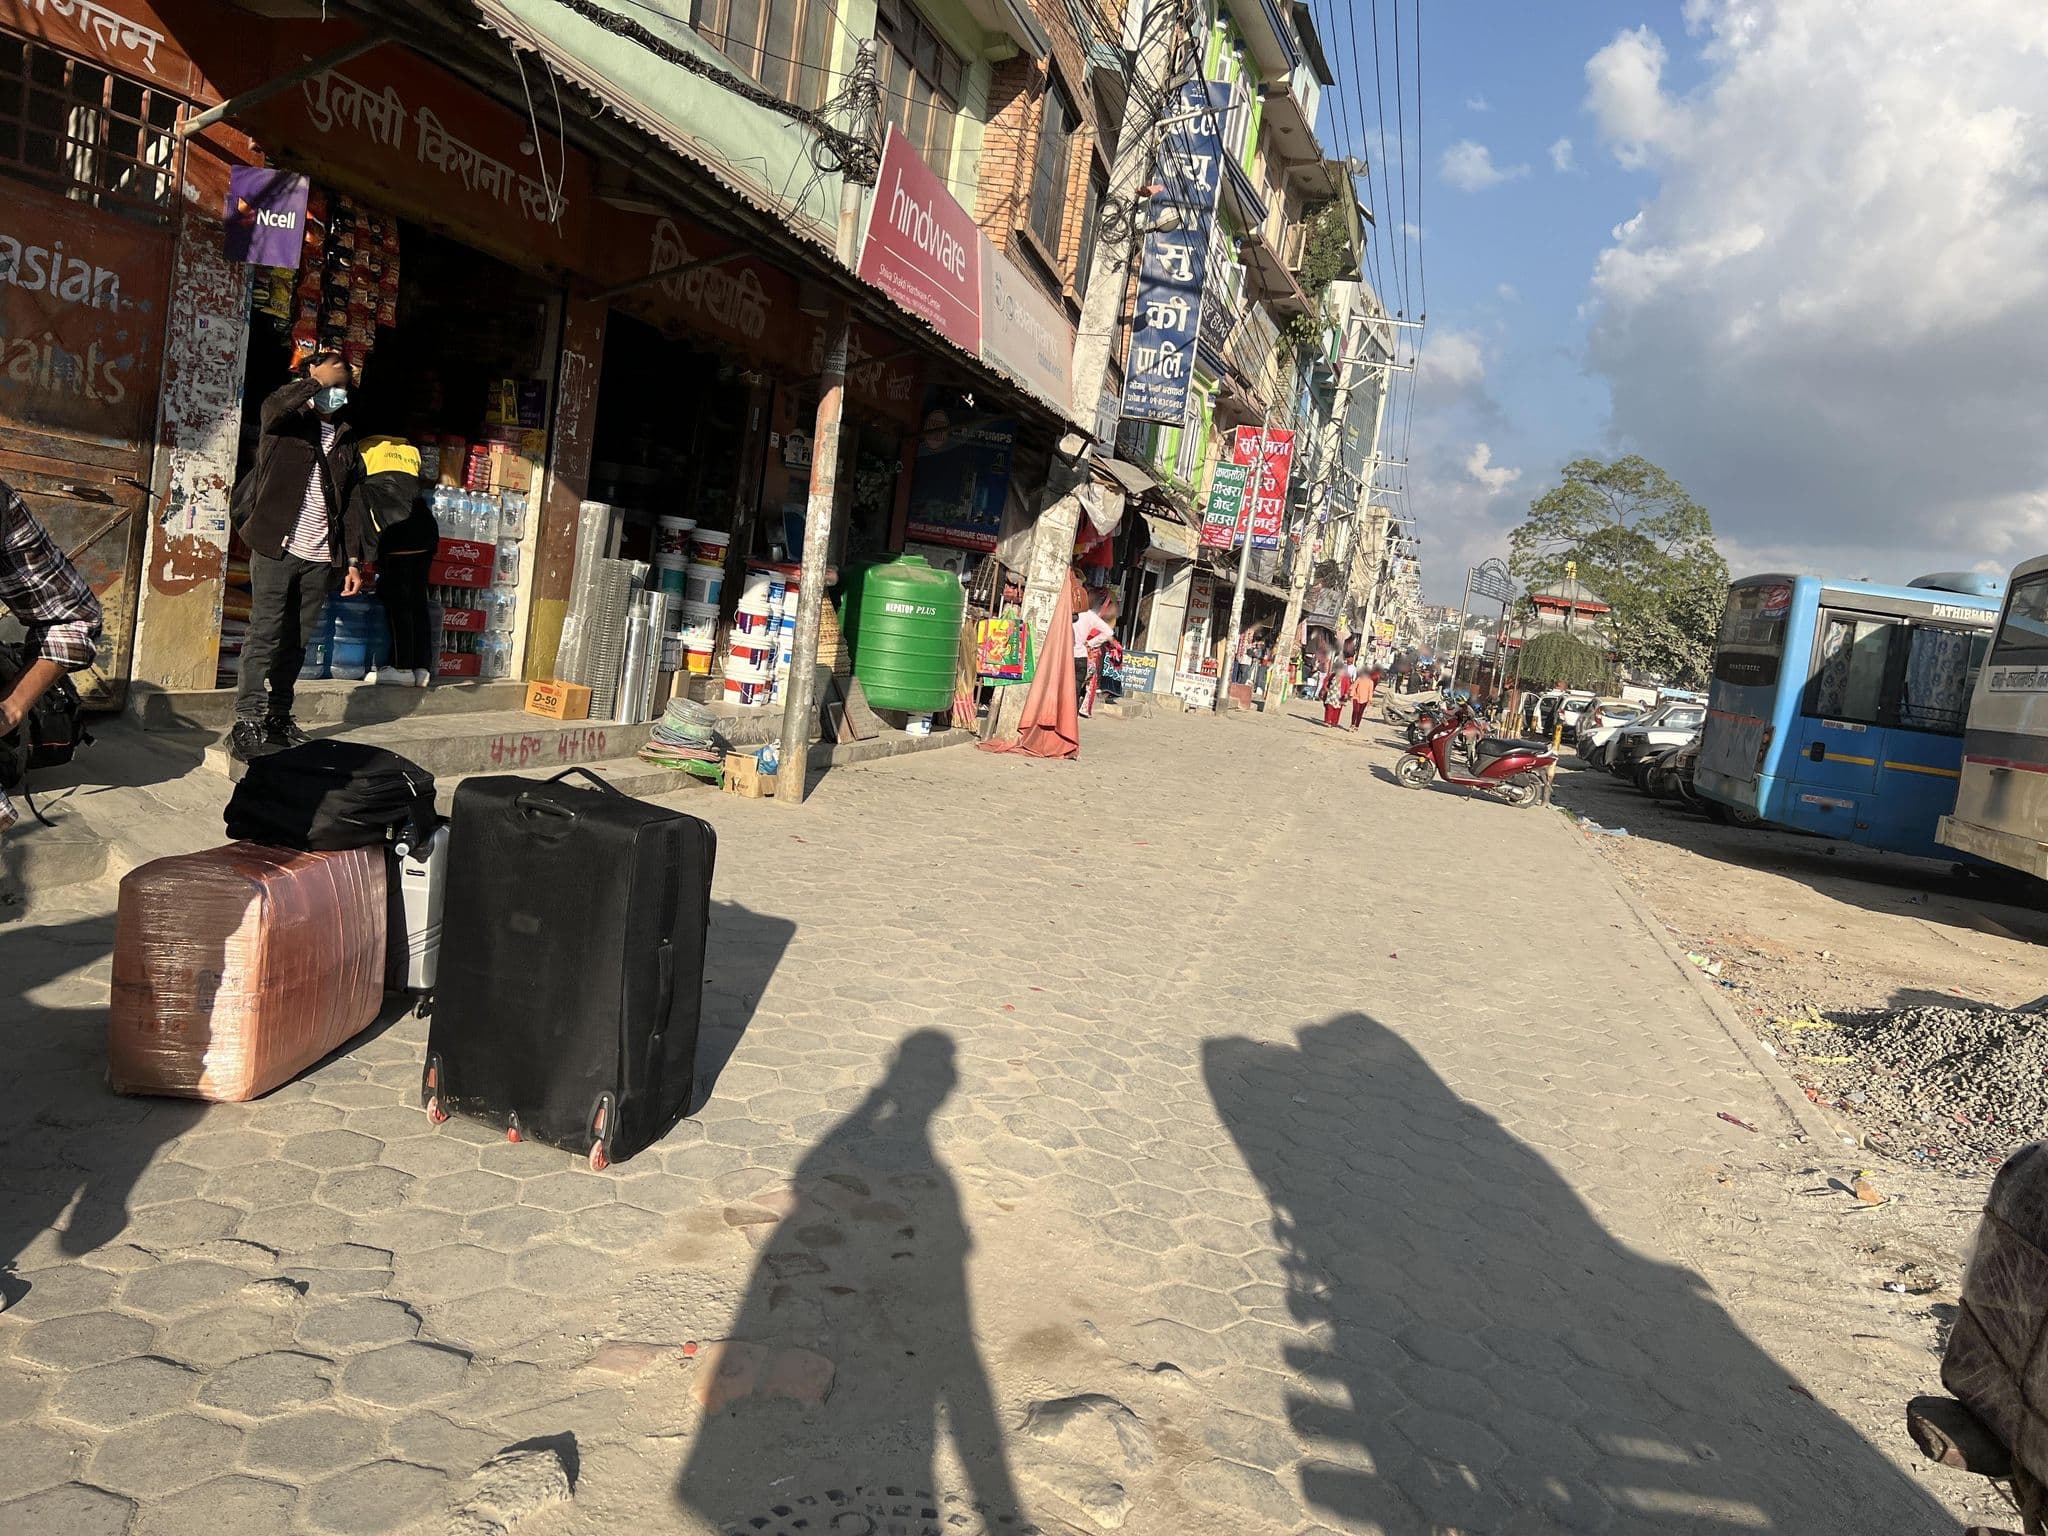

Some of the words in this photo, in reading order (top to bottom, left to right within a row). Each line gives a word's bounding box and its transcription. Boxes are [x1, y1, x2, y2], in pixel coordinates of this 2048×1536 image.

[413, 106, 516, 206] किराना
[255, 208, 297, 229] Ncell
[888, 167, 967, 283] hindware
[977, 430, 1013, 444] PUMPS
[916, 606, 937, 616] PLUS
[533, 692, 558, 706] D-50
